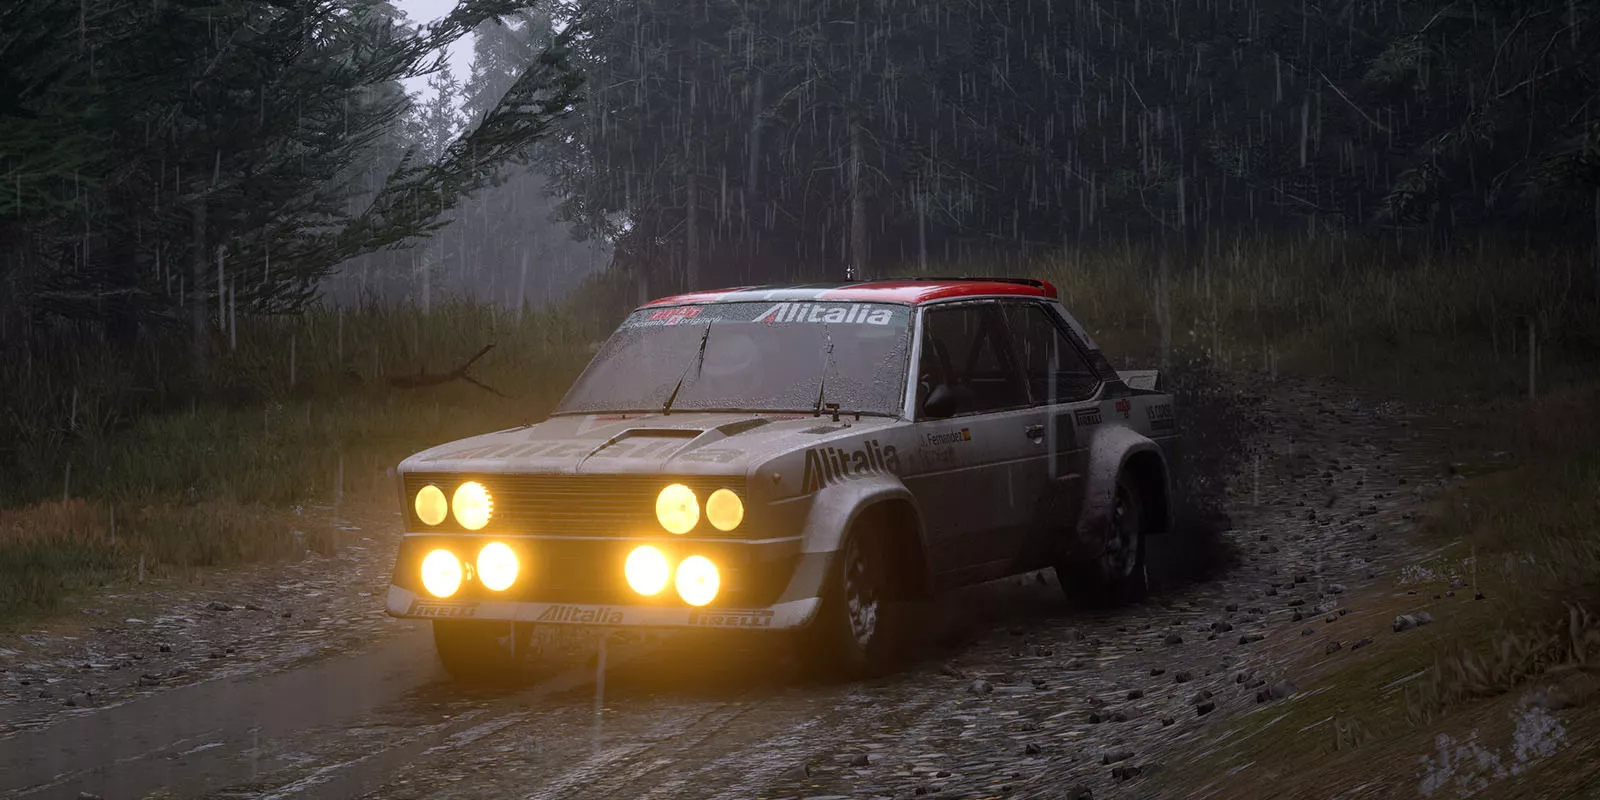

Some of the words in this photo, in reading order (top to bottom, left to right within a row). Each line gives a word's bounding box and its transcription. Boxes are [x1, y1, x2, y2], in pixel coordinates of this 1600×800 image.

[751, 302, 893, 325] Alitalia
[927, 428, 963, 446] Fernandez
[801, 439, 901, 494] Alitalia
[407, 599, 480, 617] PIRELLI
[536, 604, 624, 625] Alitalia
[688, 607, 775, 627] PIRELLI
